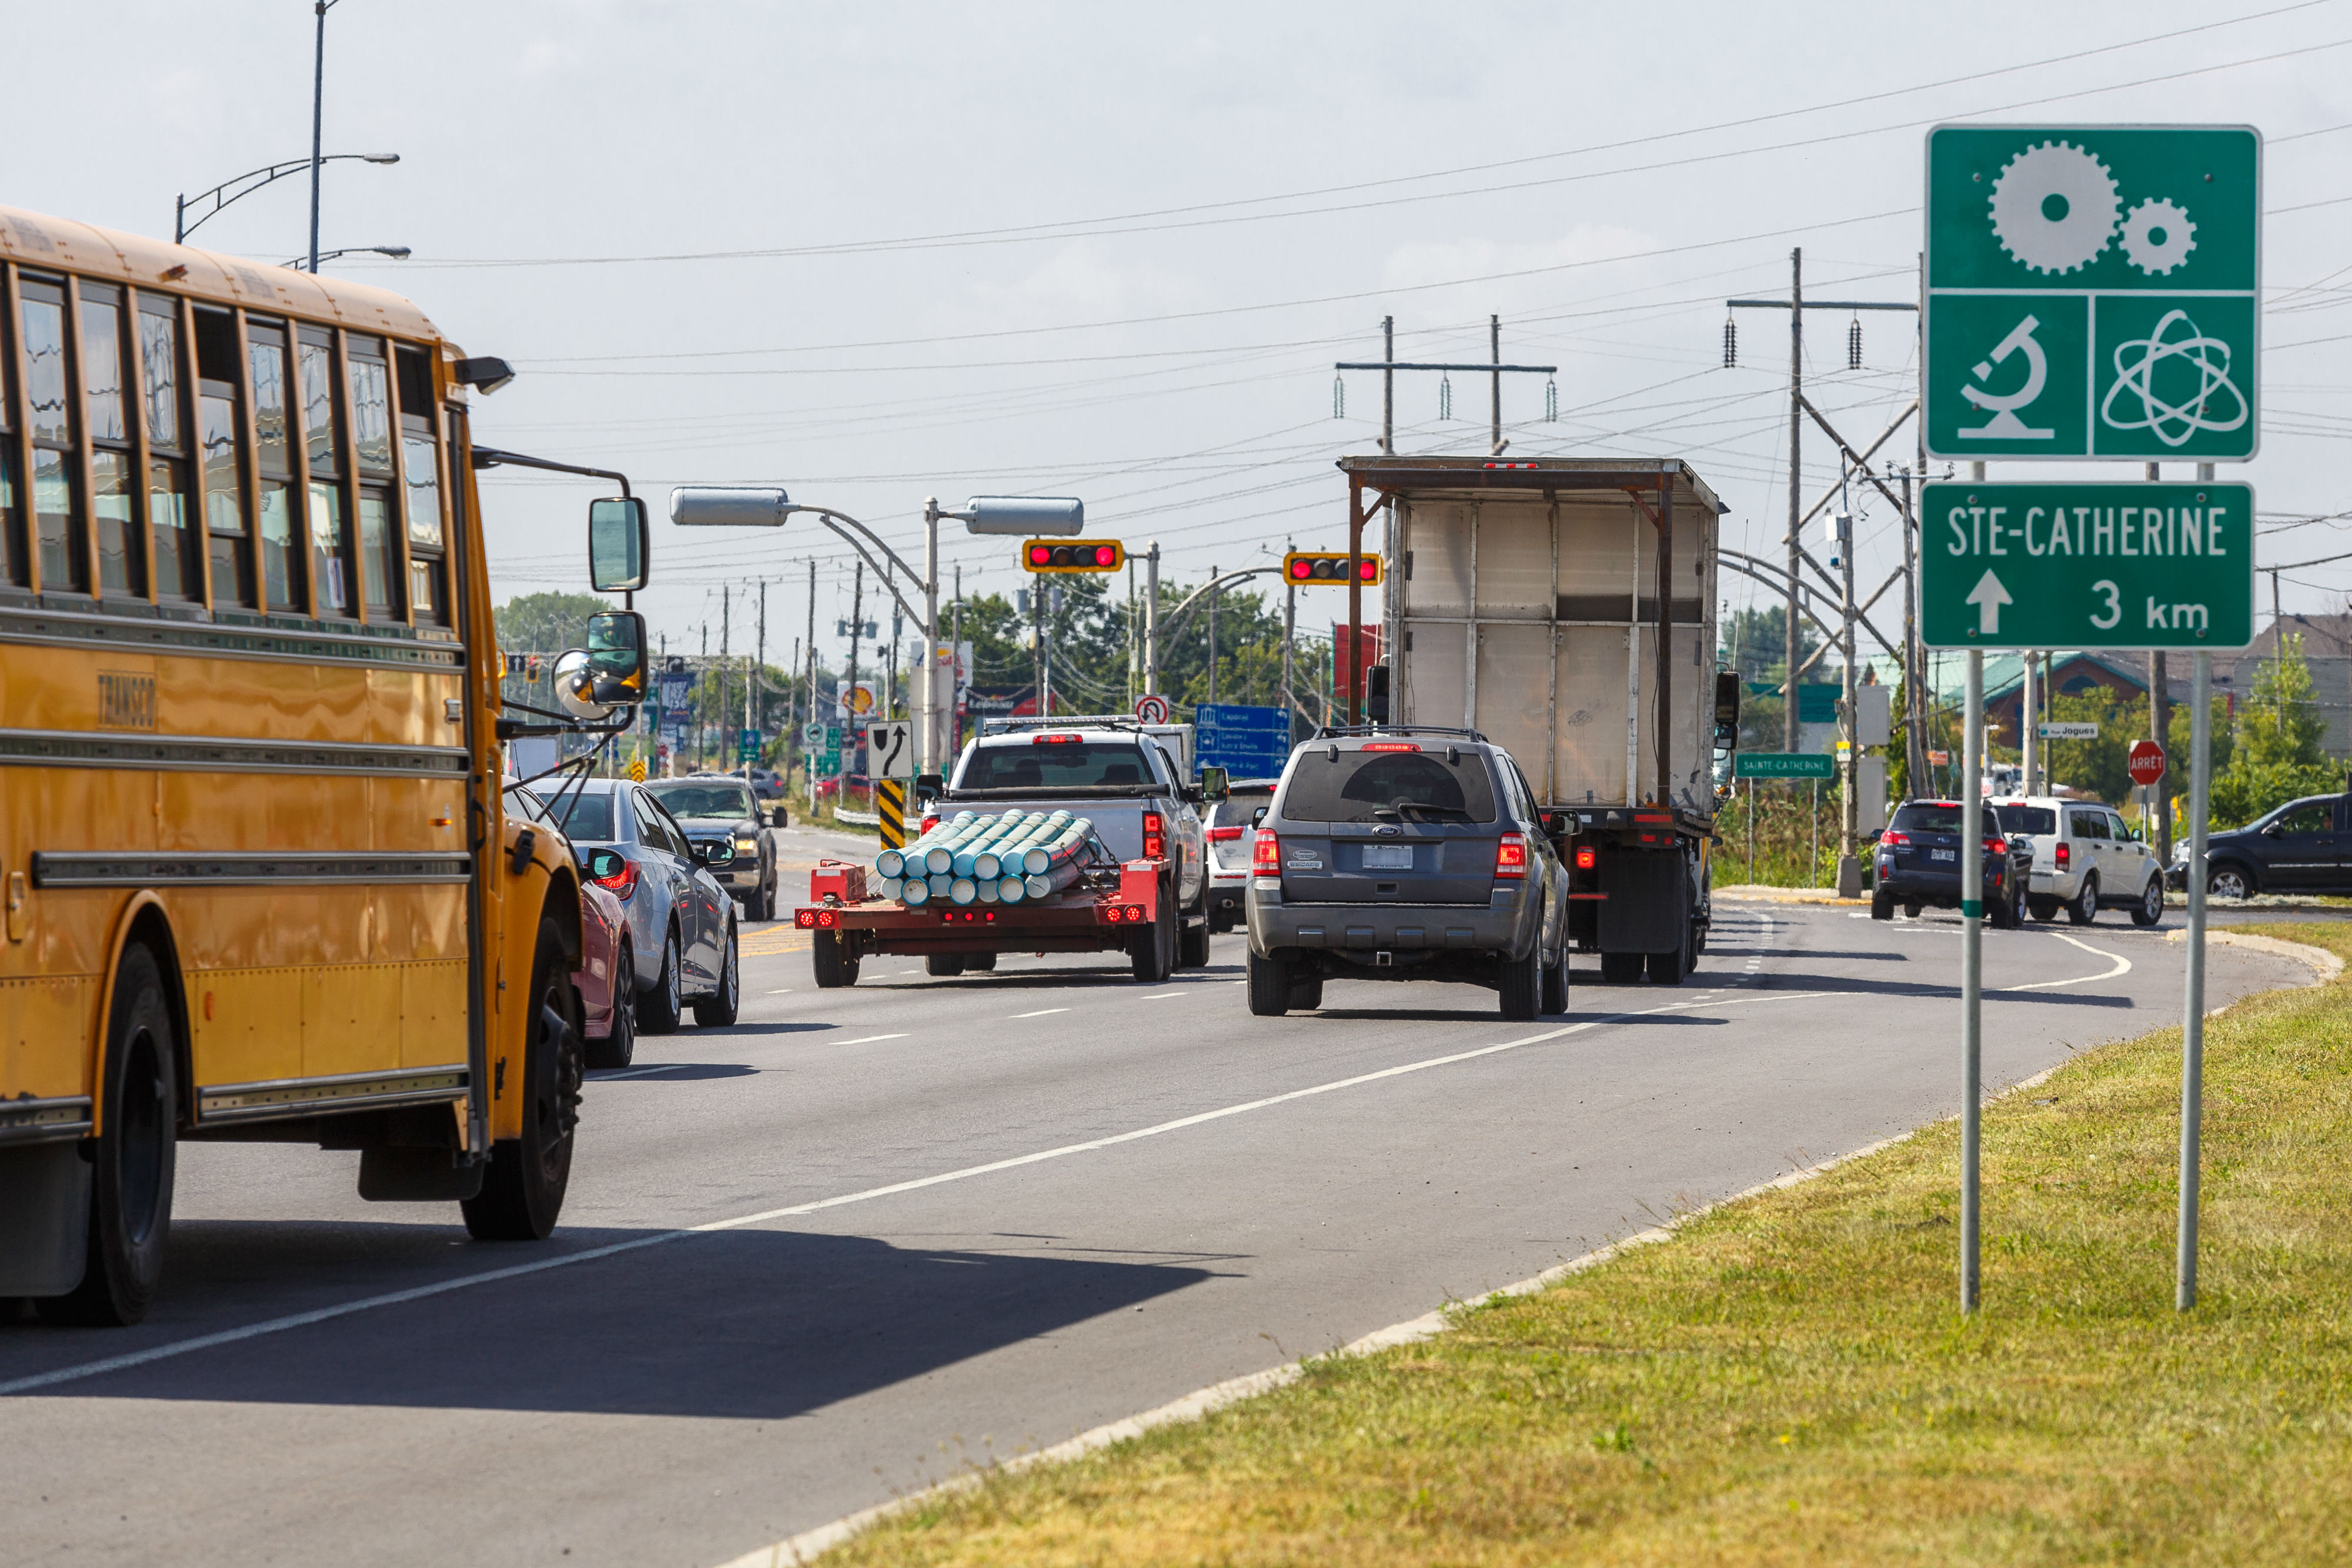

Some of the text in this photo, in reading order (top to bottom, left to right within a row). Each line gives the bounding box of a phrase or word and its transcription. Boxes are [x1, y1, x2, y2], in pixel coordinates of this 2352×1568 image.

[1947, 506, 2227, 556] STE-CATHERINE
[2089, 579, 2209, 629] 3 km
[98, 674, 155, 727] TRANSCO
[2062, 726, 2095, 736] Jogues
[2130, 754, 2163, 770] ARRÊT
